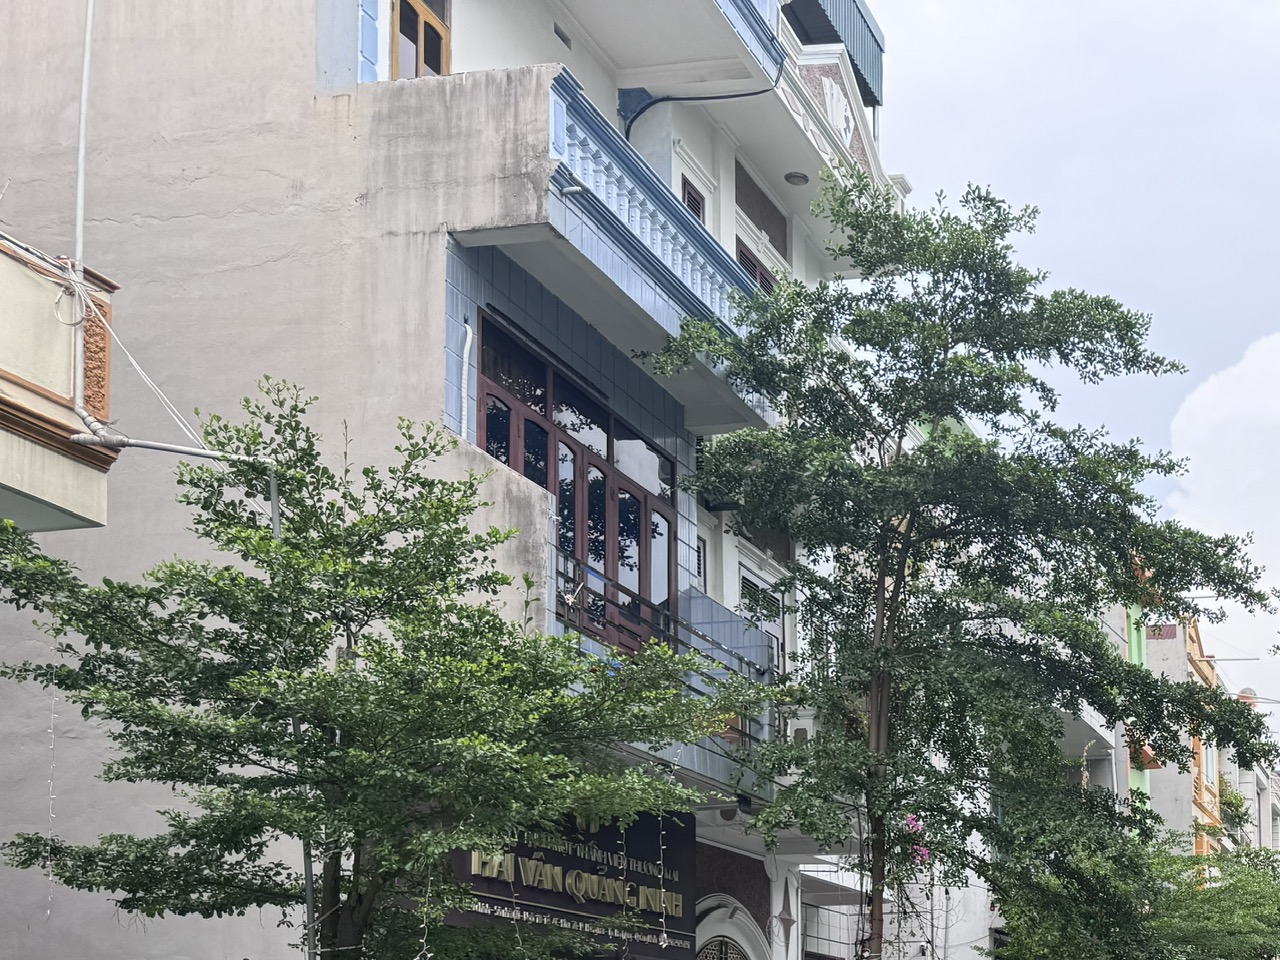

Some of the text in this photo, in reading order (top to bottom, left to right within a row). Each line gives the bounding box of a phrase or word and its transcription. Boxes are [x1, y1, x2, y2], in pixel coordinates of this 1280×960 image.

[518, 851, 563, 893] VÂN
[566, 865, 637, 907] QUẢNG
[639, 885, 683, 918] NINH
